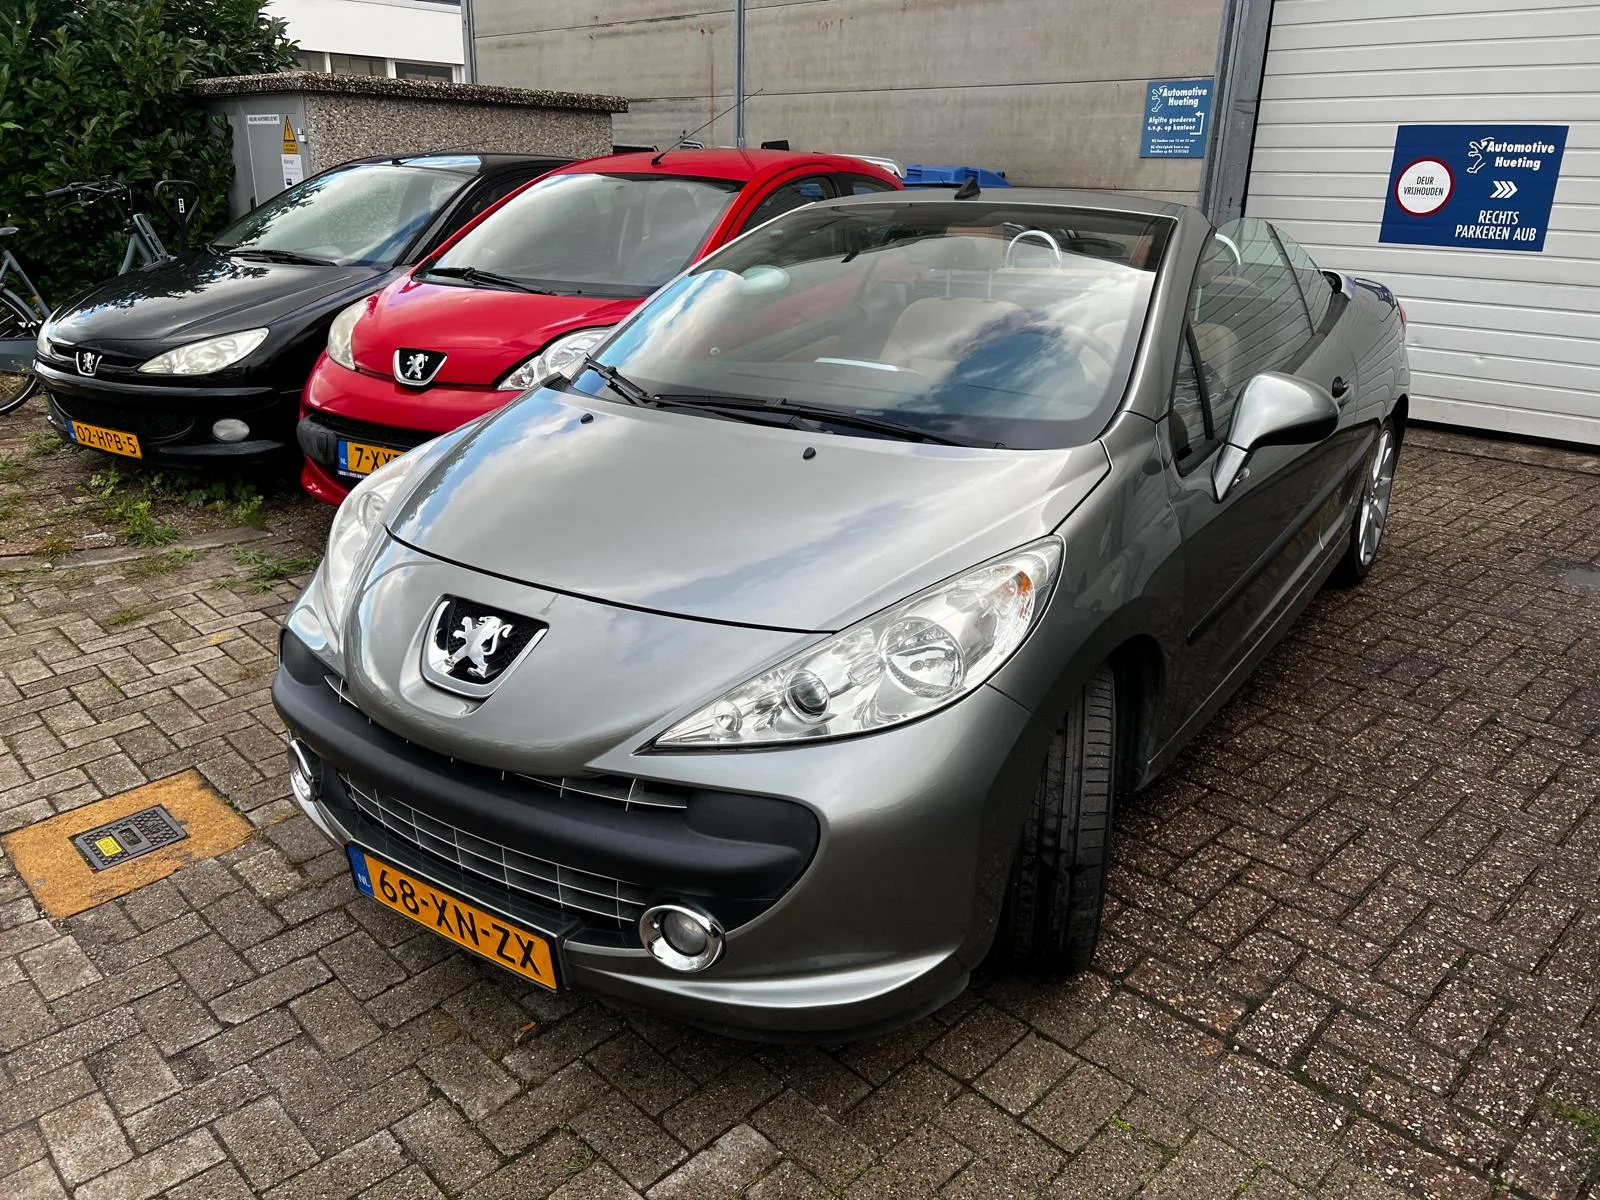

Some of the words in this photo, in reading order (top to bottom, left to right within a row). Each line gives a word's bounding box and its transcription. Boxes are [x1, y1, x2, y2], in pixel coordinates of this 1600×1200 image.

[1162, 87, 1207, 97] Automotive
[1168, 97, 1199, 107] Hueting
[1486, 141, 1555, 154] Automotive
[1494, 157, 1541, 171] Hueting
[1416, 176, 1434, 185] DEUR
[1403, 186, 1444, 196] VRIJHOUDEN
[1478, 210, 1520, 225] RECHTS
[1454, 225, 1511, 241] PARKEREN
[1513, 227, 1537, 241] AUB
[76, 425, 137, 454] 02-HPB-5
[340, 457, 347, 465] NL
[357, 872, 371, 888] NL
[379, 869, 541, 976] 68-XN-ZX
